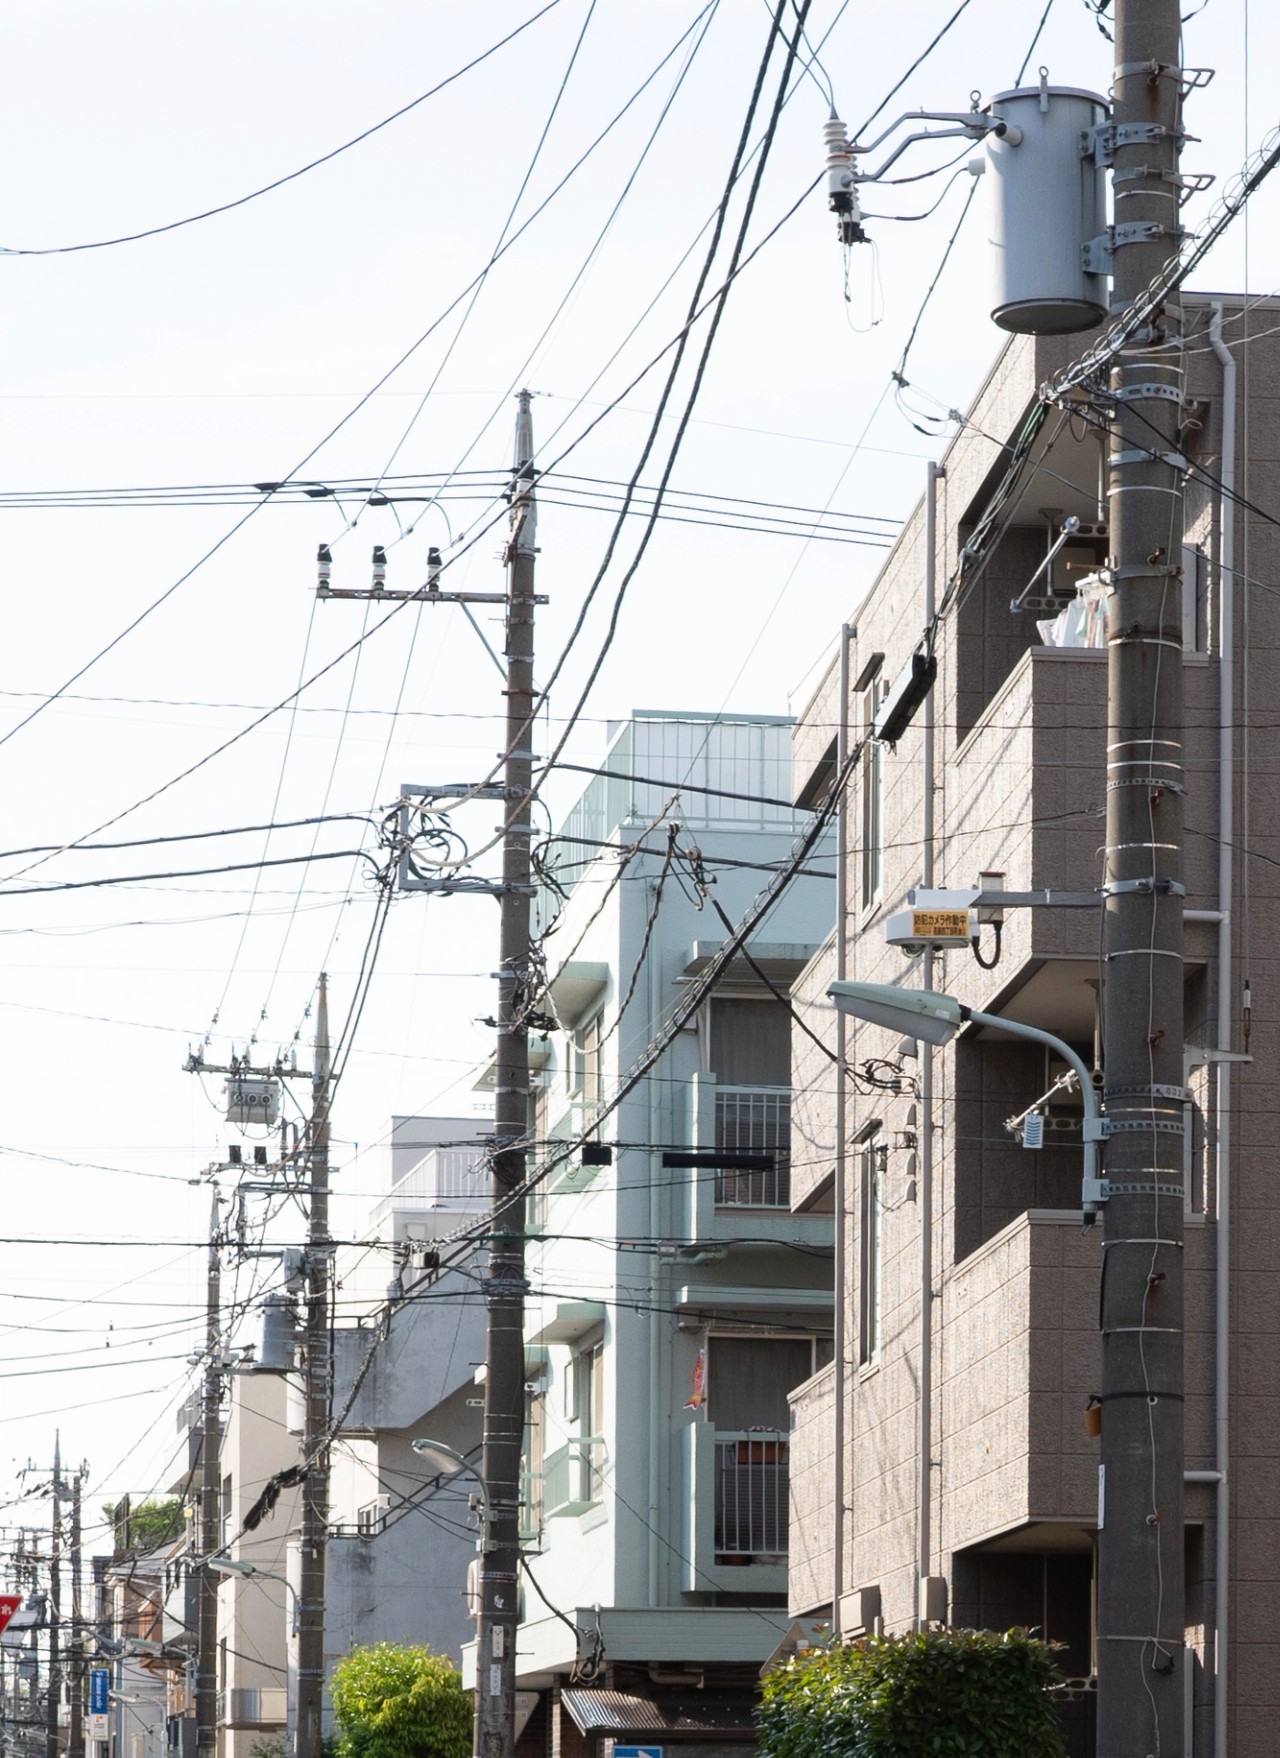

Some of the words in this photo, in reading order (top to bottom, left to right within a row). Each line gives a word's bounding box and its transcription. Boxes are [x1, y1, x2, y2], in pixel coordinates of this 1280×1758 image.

[914, 914, 967, 927] 防犯カメラ作動中
